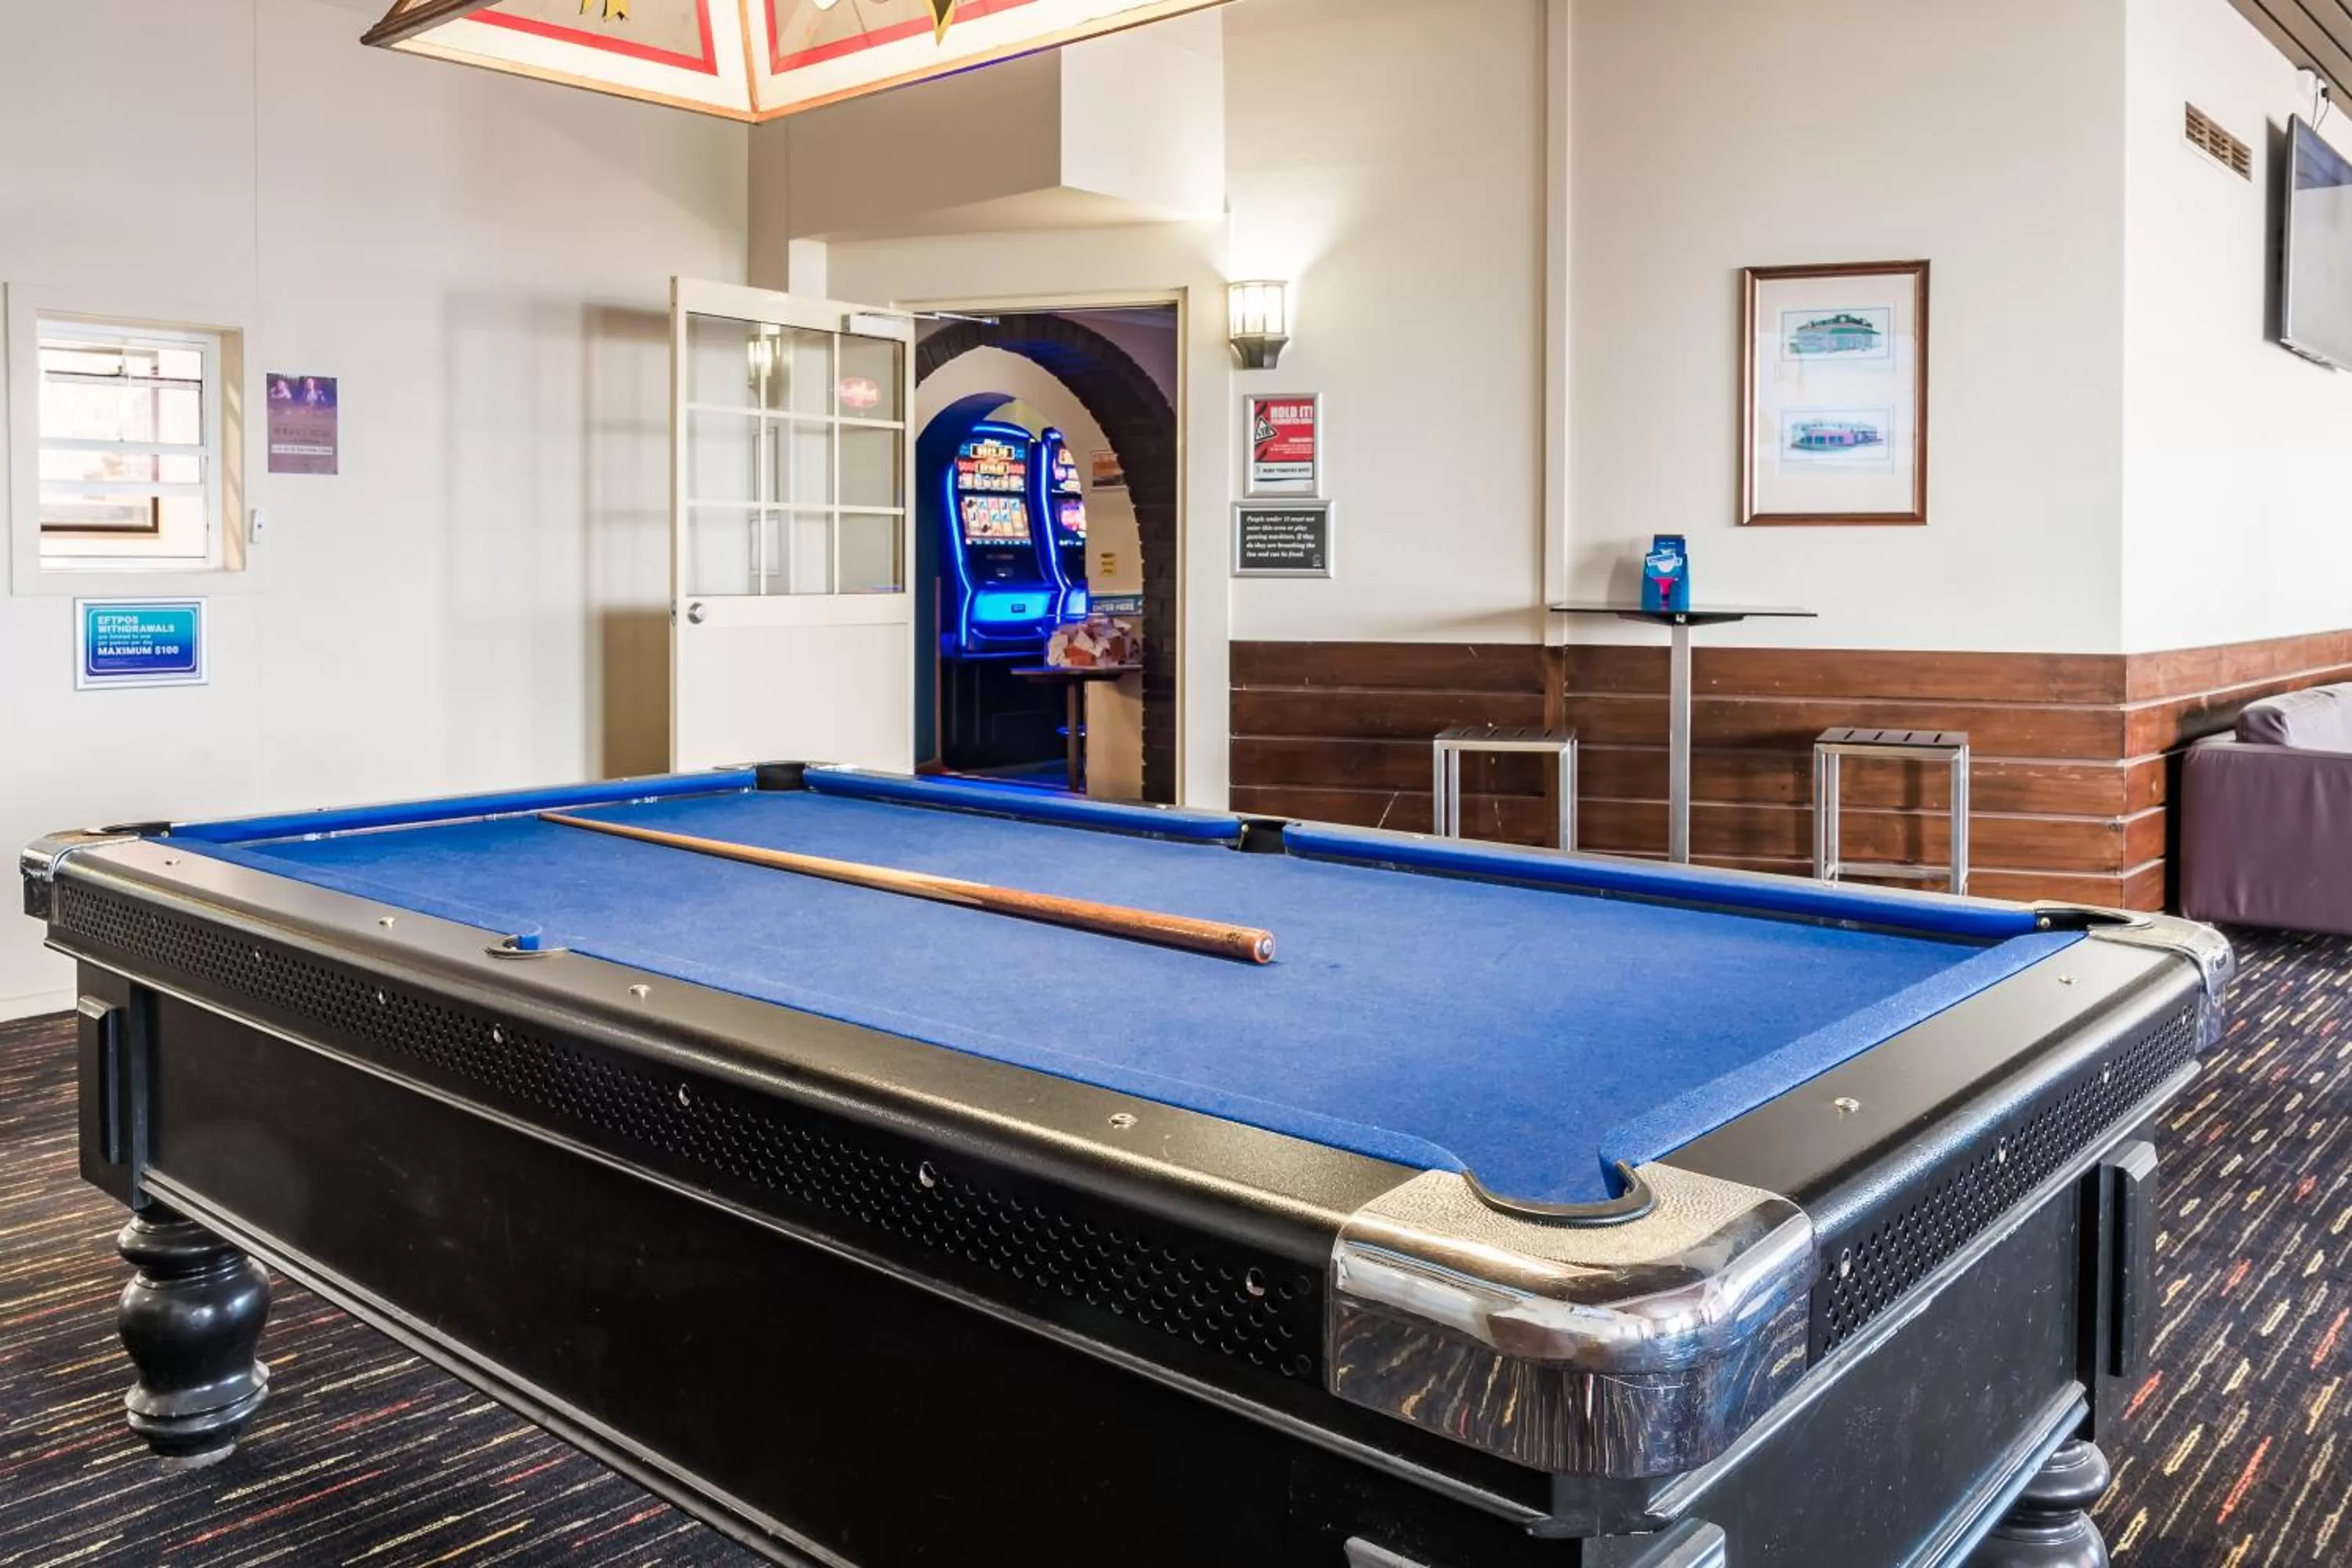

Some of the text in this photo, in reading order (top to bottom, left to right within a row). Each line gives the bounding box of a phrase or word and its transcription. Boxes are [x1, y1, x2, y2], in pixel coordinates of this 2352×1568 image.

[98, 615, 139, 625] EFTPOS
[98, 623, 175, 633] WITHDRAWALS
[97, 645, 180, 655] MAXIMUM $100
